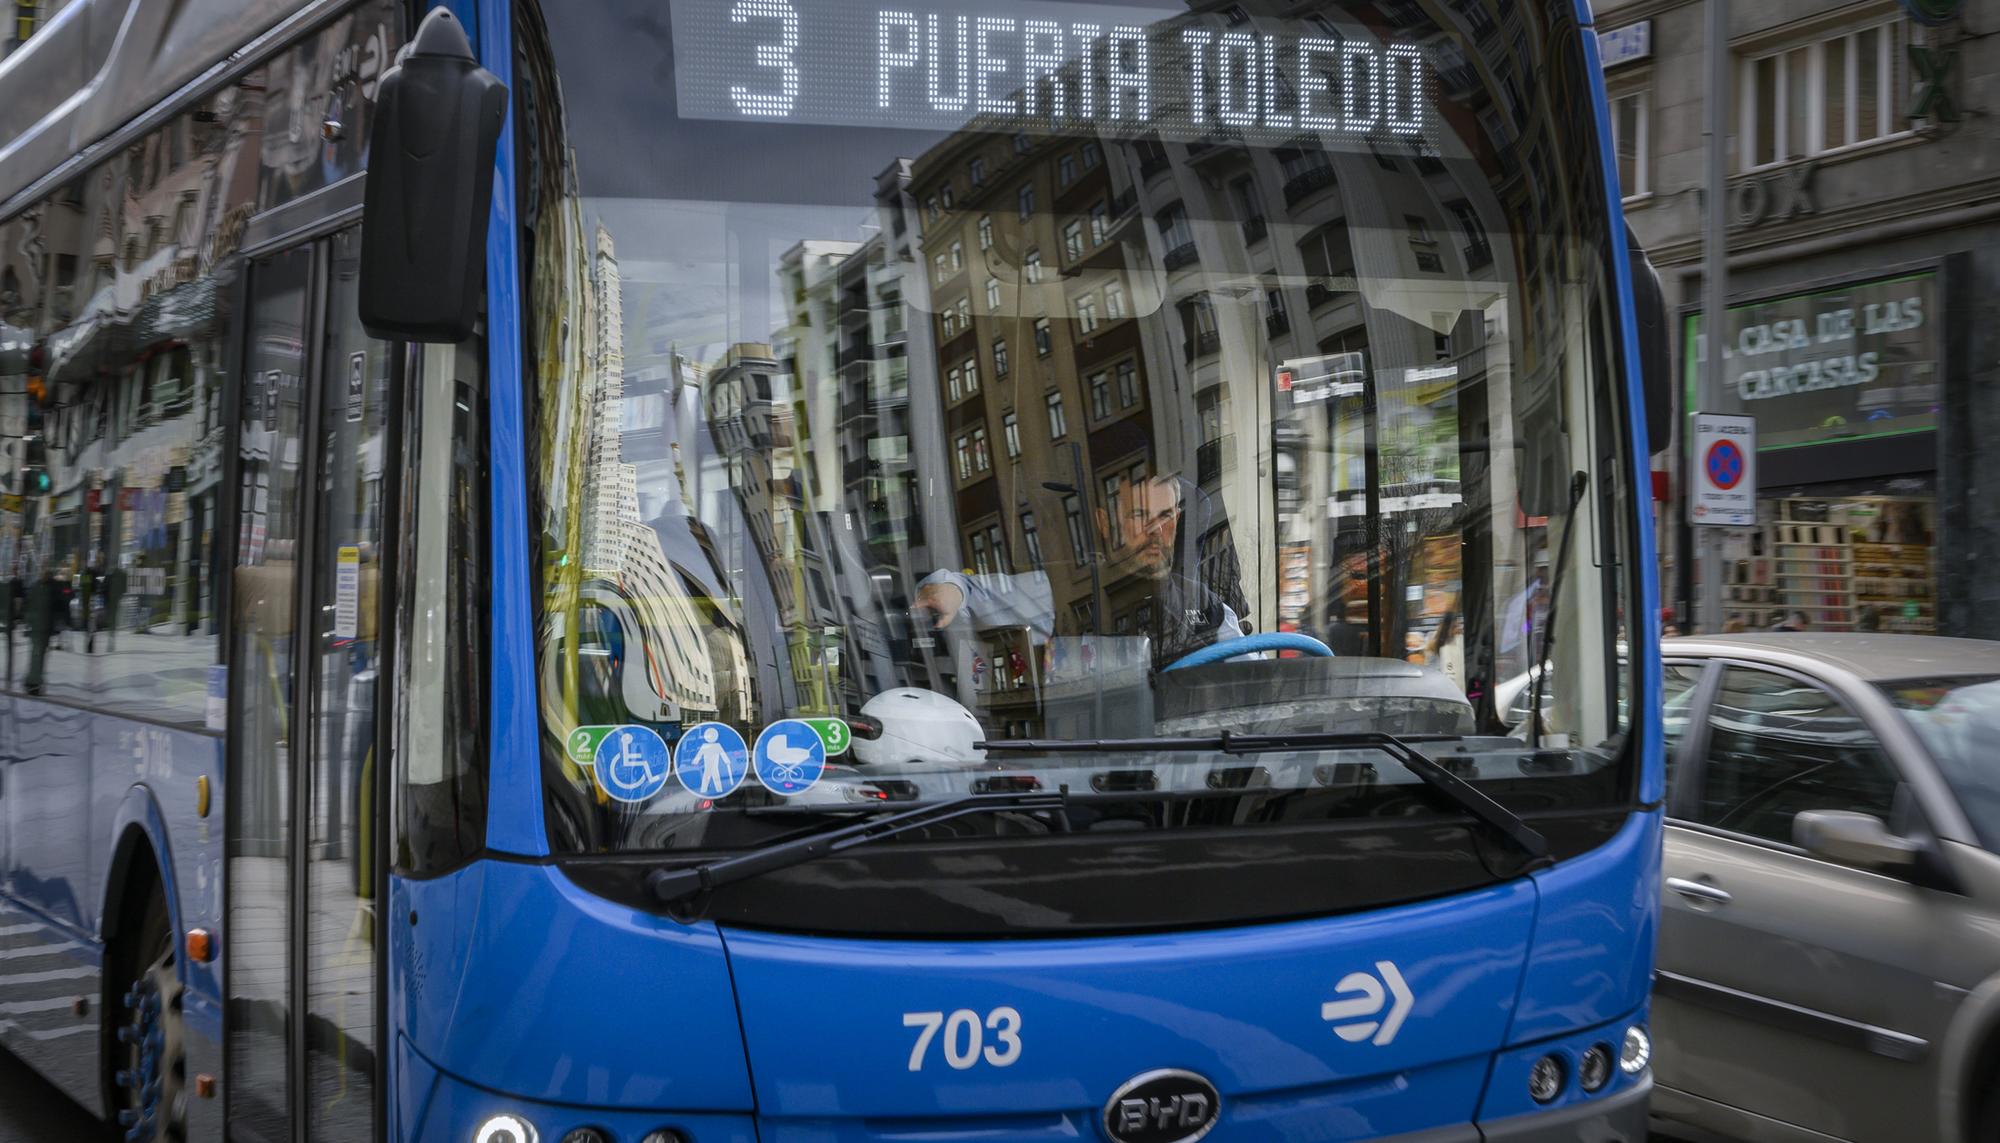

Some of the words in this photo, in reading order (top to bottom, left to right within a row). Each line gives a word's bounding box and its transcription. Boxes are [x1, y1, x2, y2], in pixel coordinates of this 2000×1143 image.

[731, 0, 799, 117] 3
[879, 11, 1148, 122] PUERTA
[1183, 29, 1423, 135] TOLEDO
[1739, 319, 1810, 356] CASA
[1816, 308, 1855, 343] DE
[1862, 297, 1923, 335] LAS
[1738, 351, 1879, 400] CARCASAS
[577, 732, 591, 752] 2
[828, 722, 841, 744] 3
[903, 1006, 1022, 1071] 703
[1118, 1092, 1207, 1132] BYD
